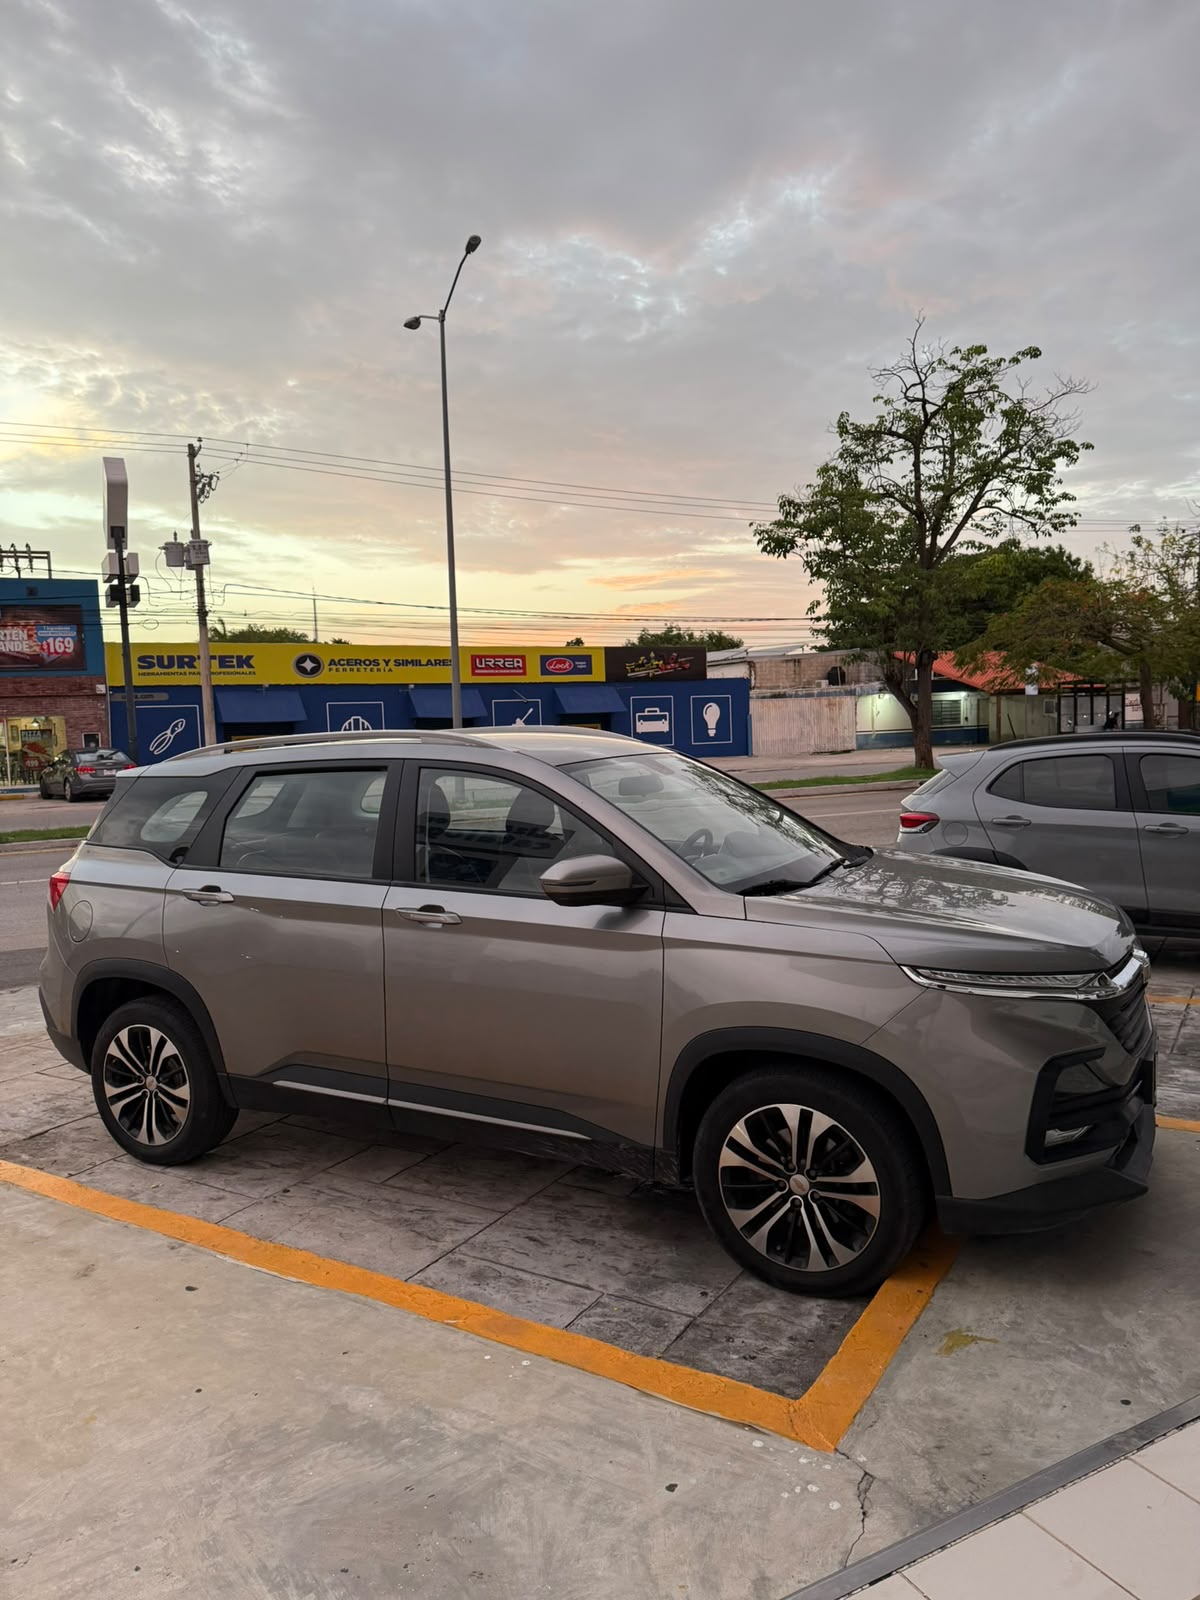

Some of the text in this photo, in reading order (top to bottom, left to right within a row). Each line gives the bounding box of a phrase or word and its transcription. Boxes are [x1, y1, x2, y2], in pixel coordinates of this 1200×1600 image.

[42, 637, 74, 653] $169
[328, 658, 380, 667] ACEROS
[383, 658, 392, 667] Y
[475, 657, 523, 668] URREA
